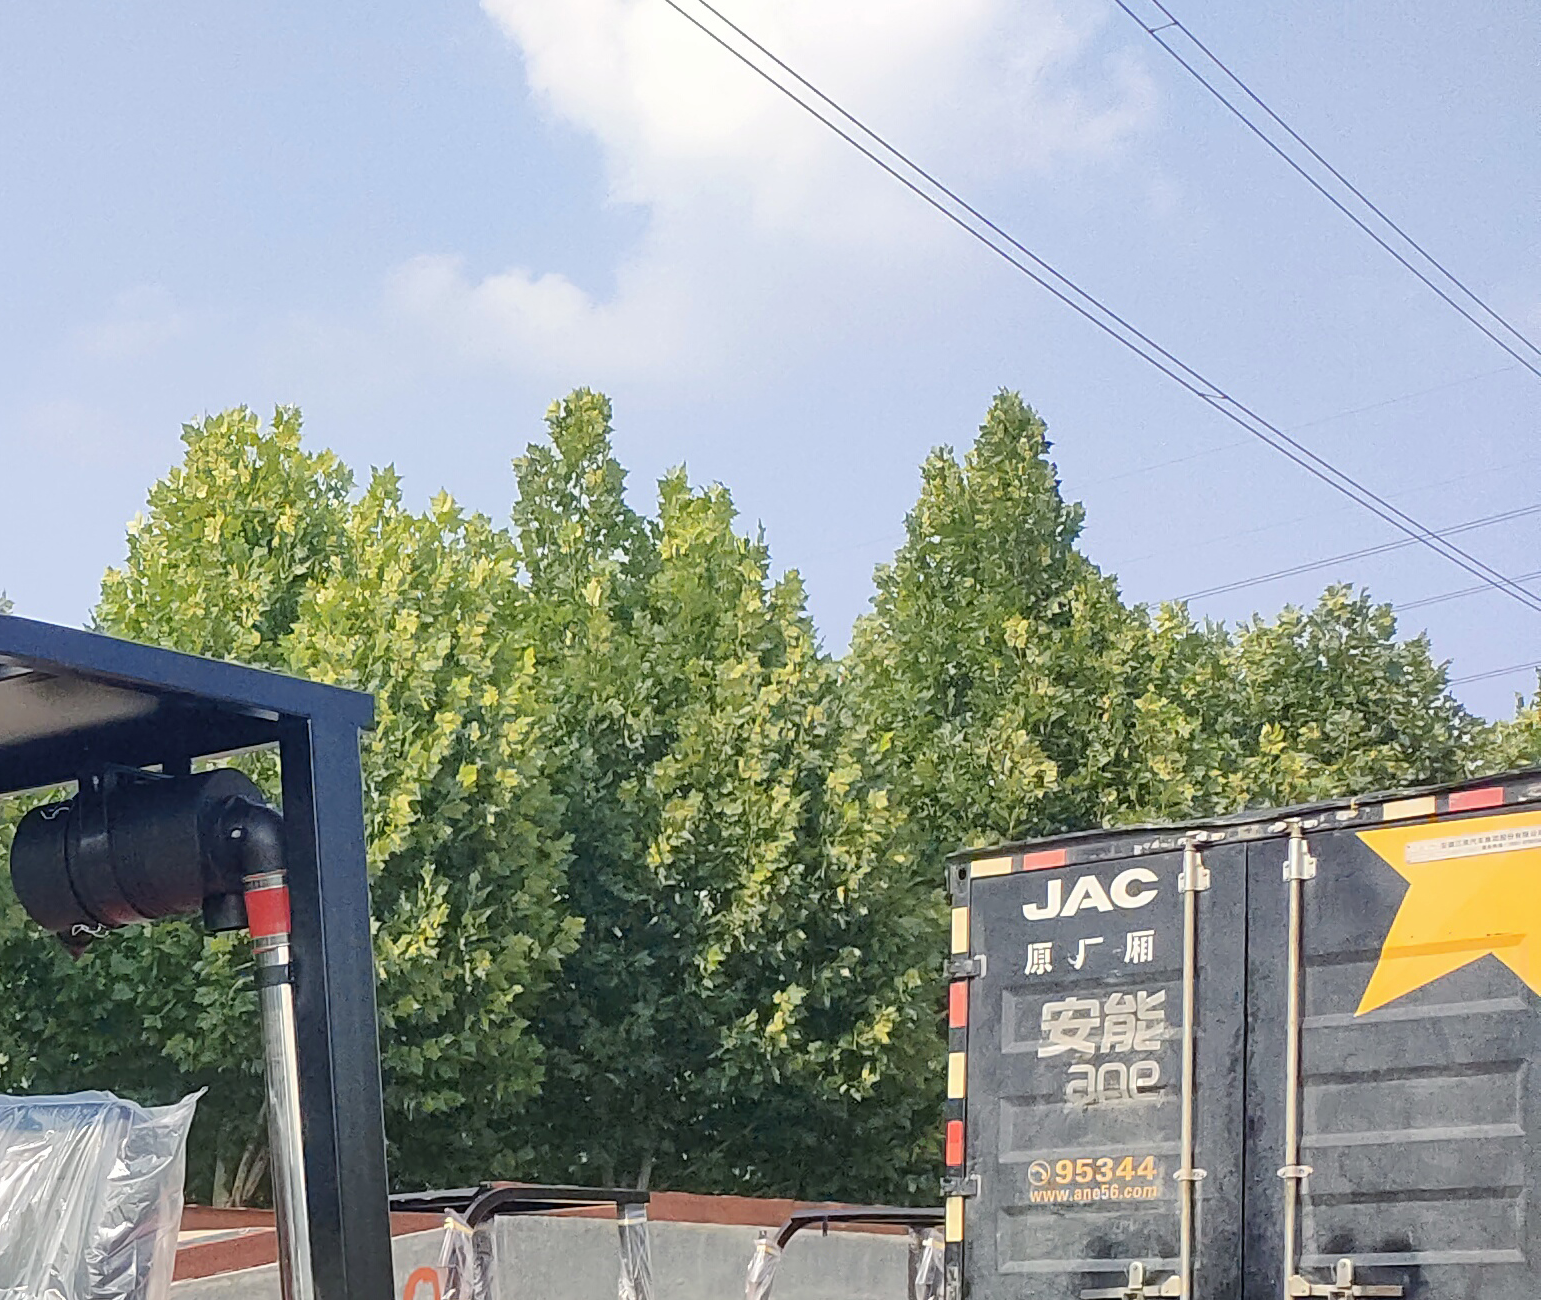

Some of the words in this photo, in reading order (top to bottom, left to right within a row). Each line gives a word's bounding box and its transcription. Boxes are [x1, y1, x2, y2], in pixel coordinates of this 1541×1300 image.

[1022, 867, 1159, 921] JAC
[1024, 929, 1155, 976] 原厂厢
[1037, 989, 1166, 1058] 安能
[1055, 1155, 1157, 1184] 95344
